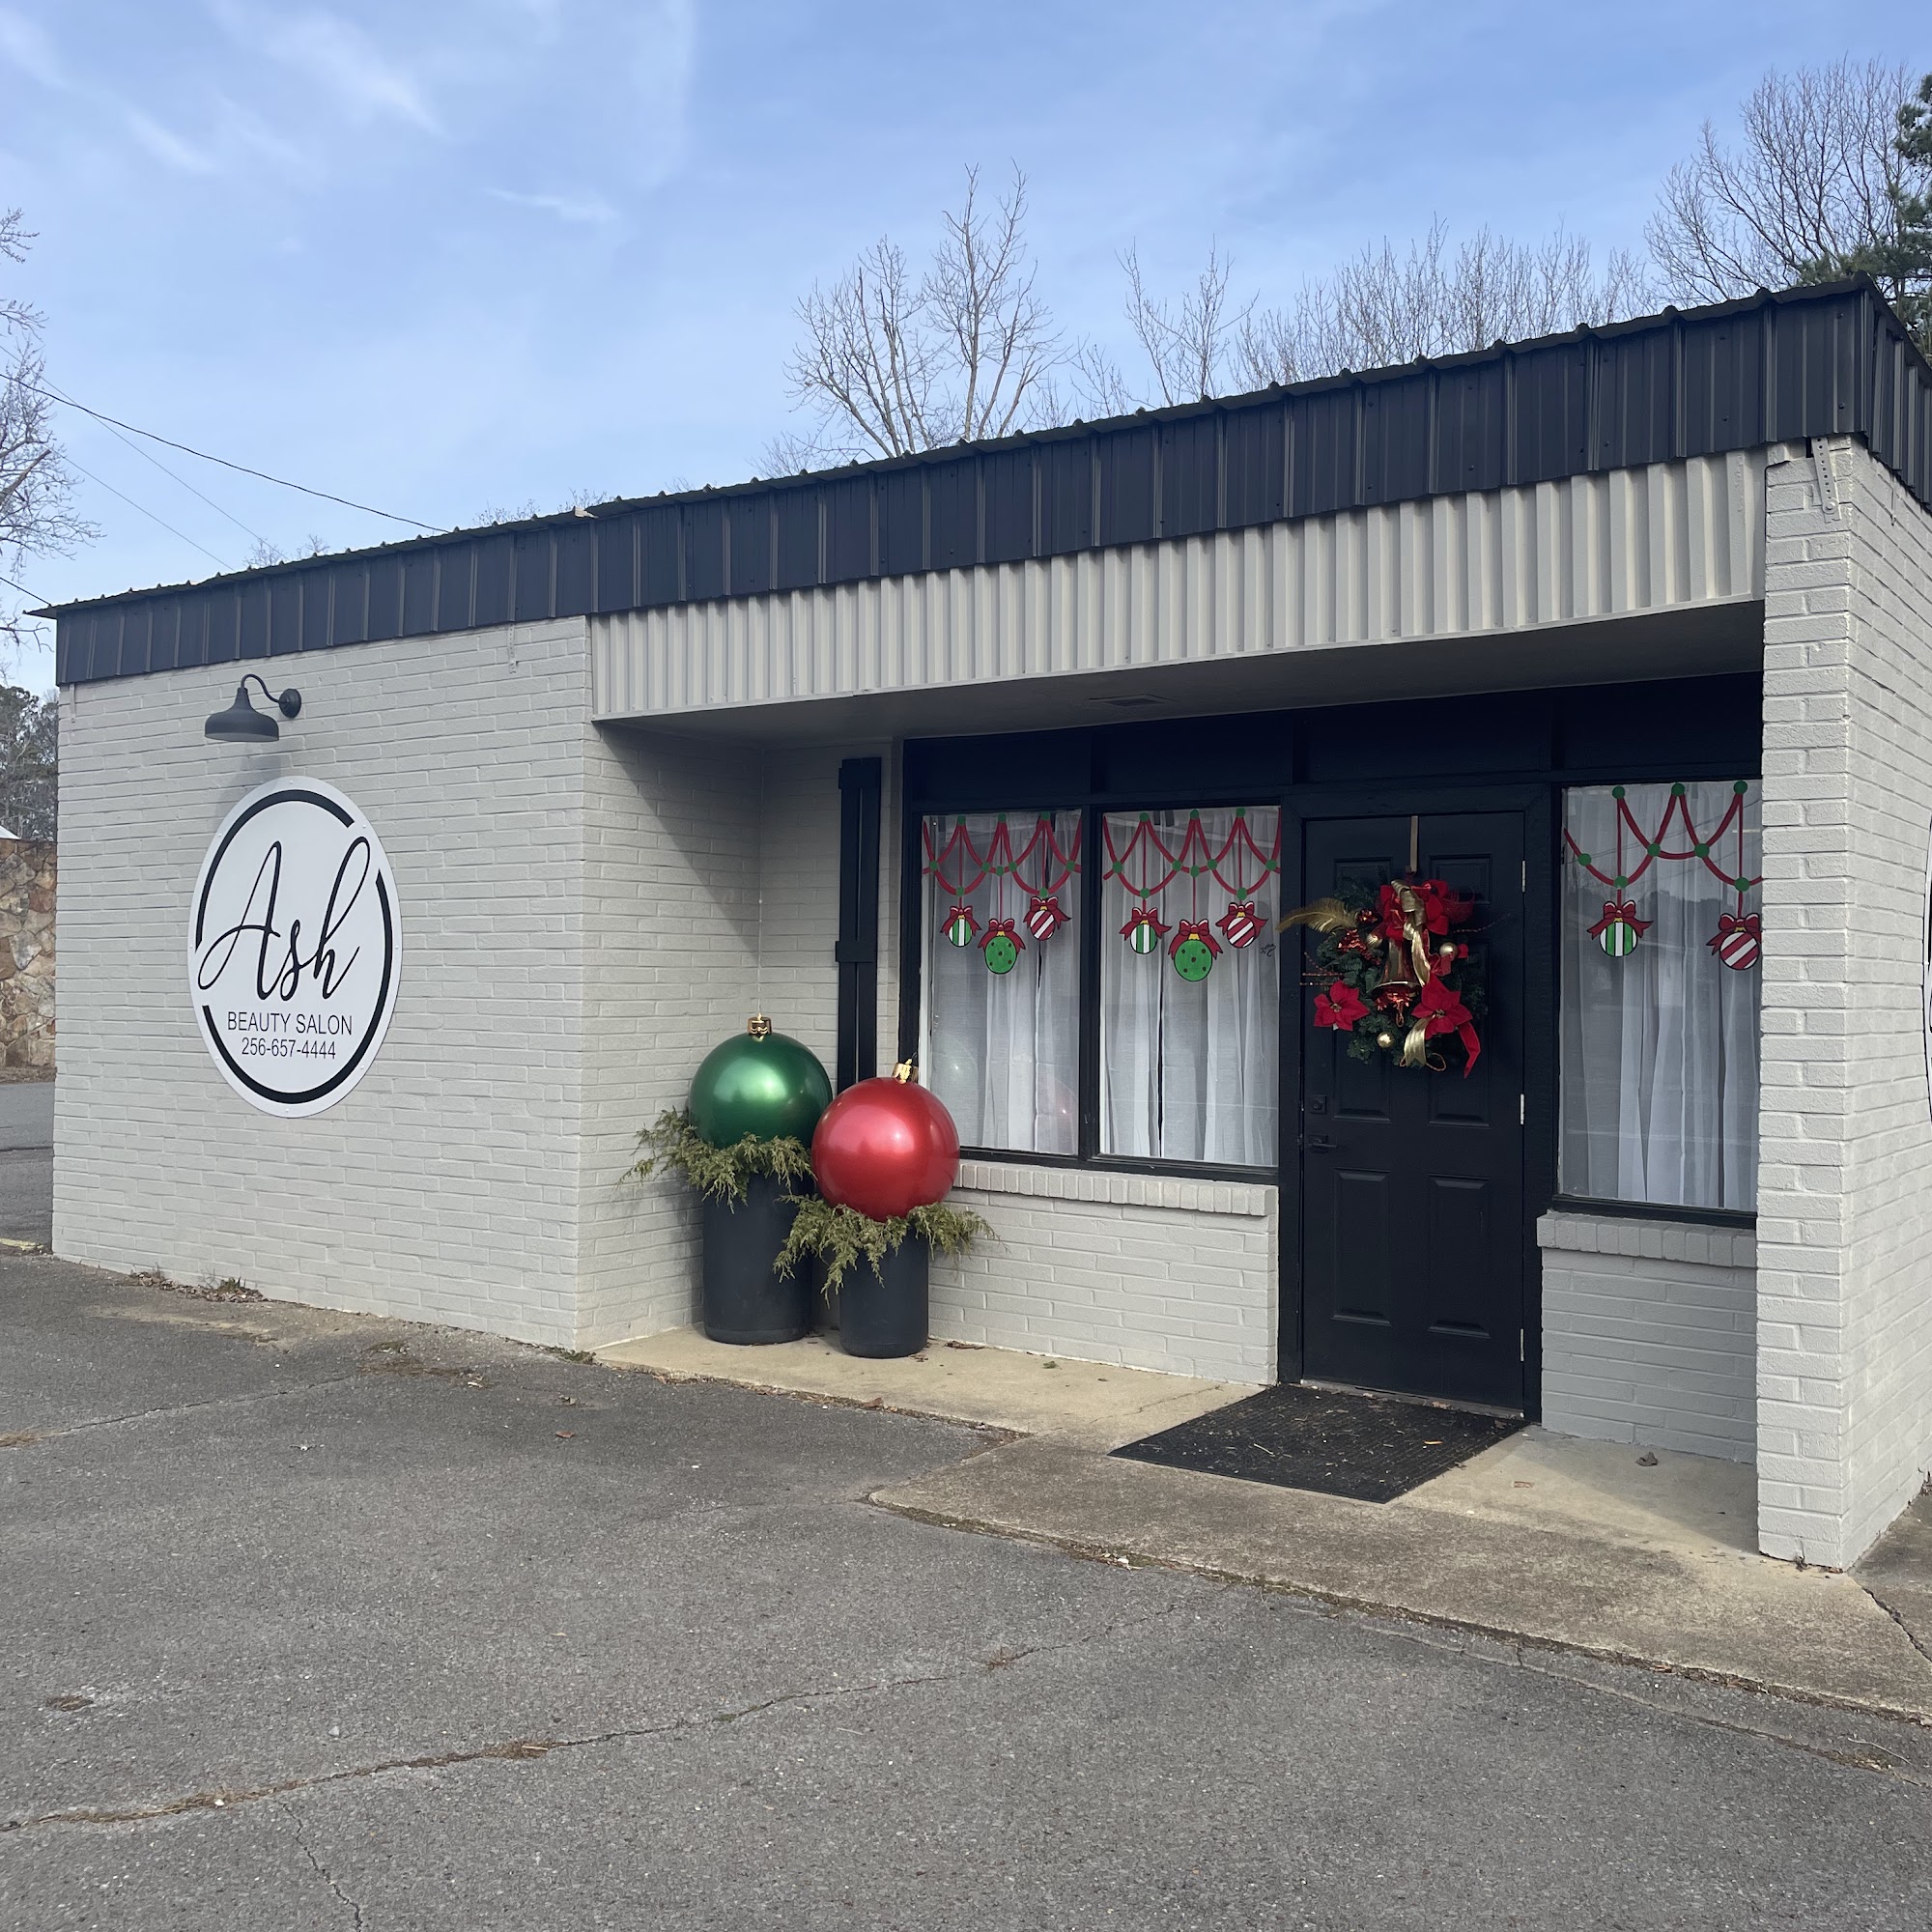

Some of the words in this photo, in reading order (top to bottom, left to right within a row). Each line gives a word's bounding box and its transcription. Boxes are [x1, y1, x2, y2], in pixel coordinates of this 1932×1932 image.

[198, 837, 371, 1001] Ash
[227, 1010, 291, 1033] BEAUTY
[296, 1013, 353, 1035] SALON
[242, 1037, 336, 1059] 256-657-4444
